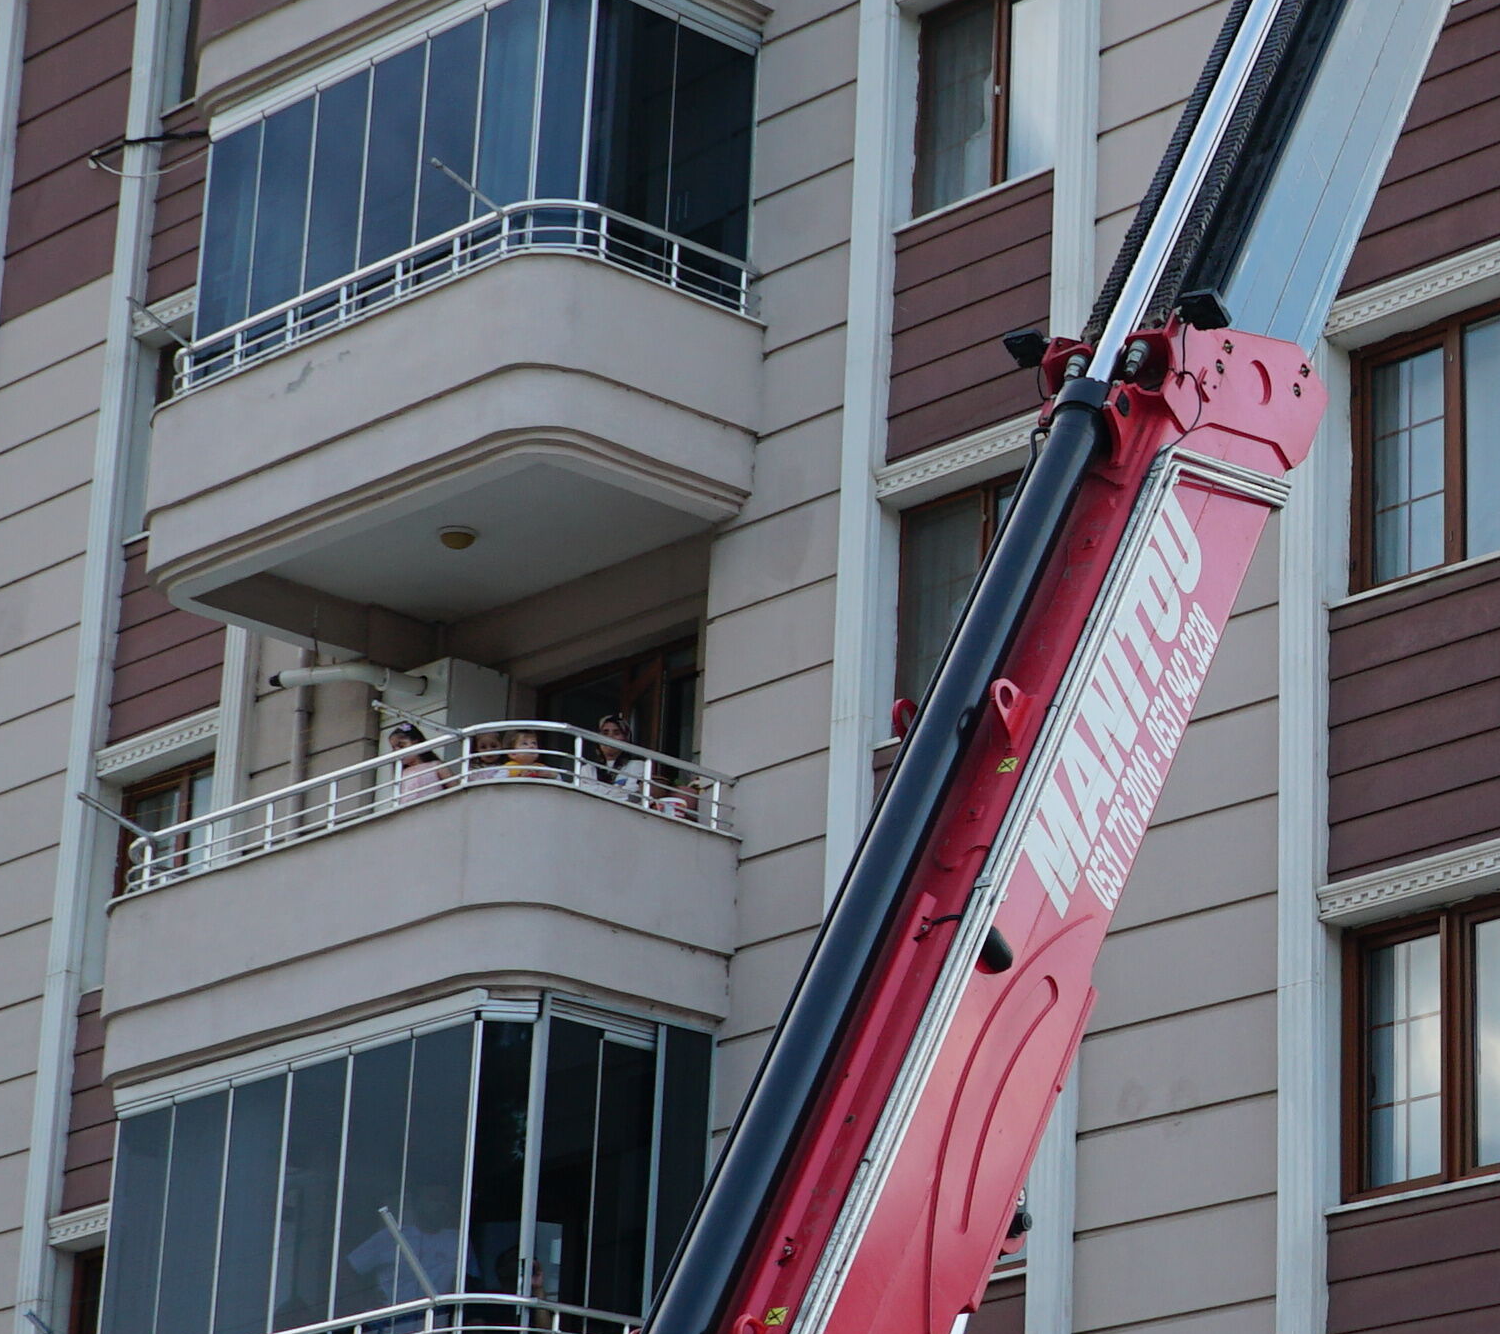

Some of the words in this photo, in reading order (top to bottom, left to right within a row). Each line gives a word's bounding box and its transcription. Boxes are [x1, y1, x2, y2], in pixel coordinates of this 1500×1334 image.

[1179, 601, 1218, 674] 3238
[1022, 485, 1202, 920] MANITOU
[1164, 663, 1200, 713] 942
[1146, 694, 1178, 760] 0531
[1123, 743, 1161, 821] 2018
[1105, 793, 1141, 859] 776
[1083, 831, 1118, 912] 0531
